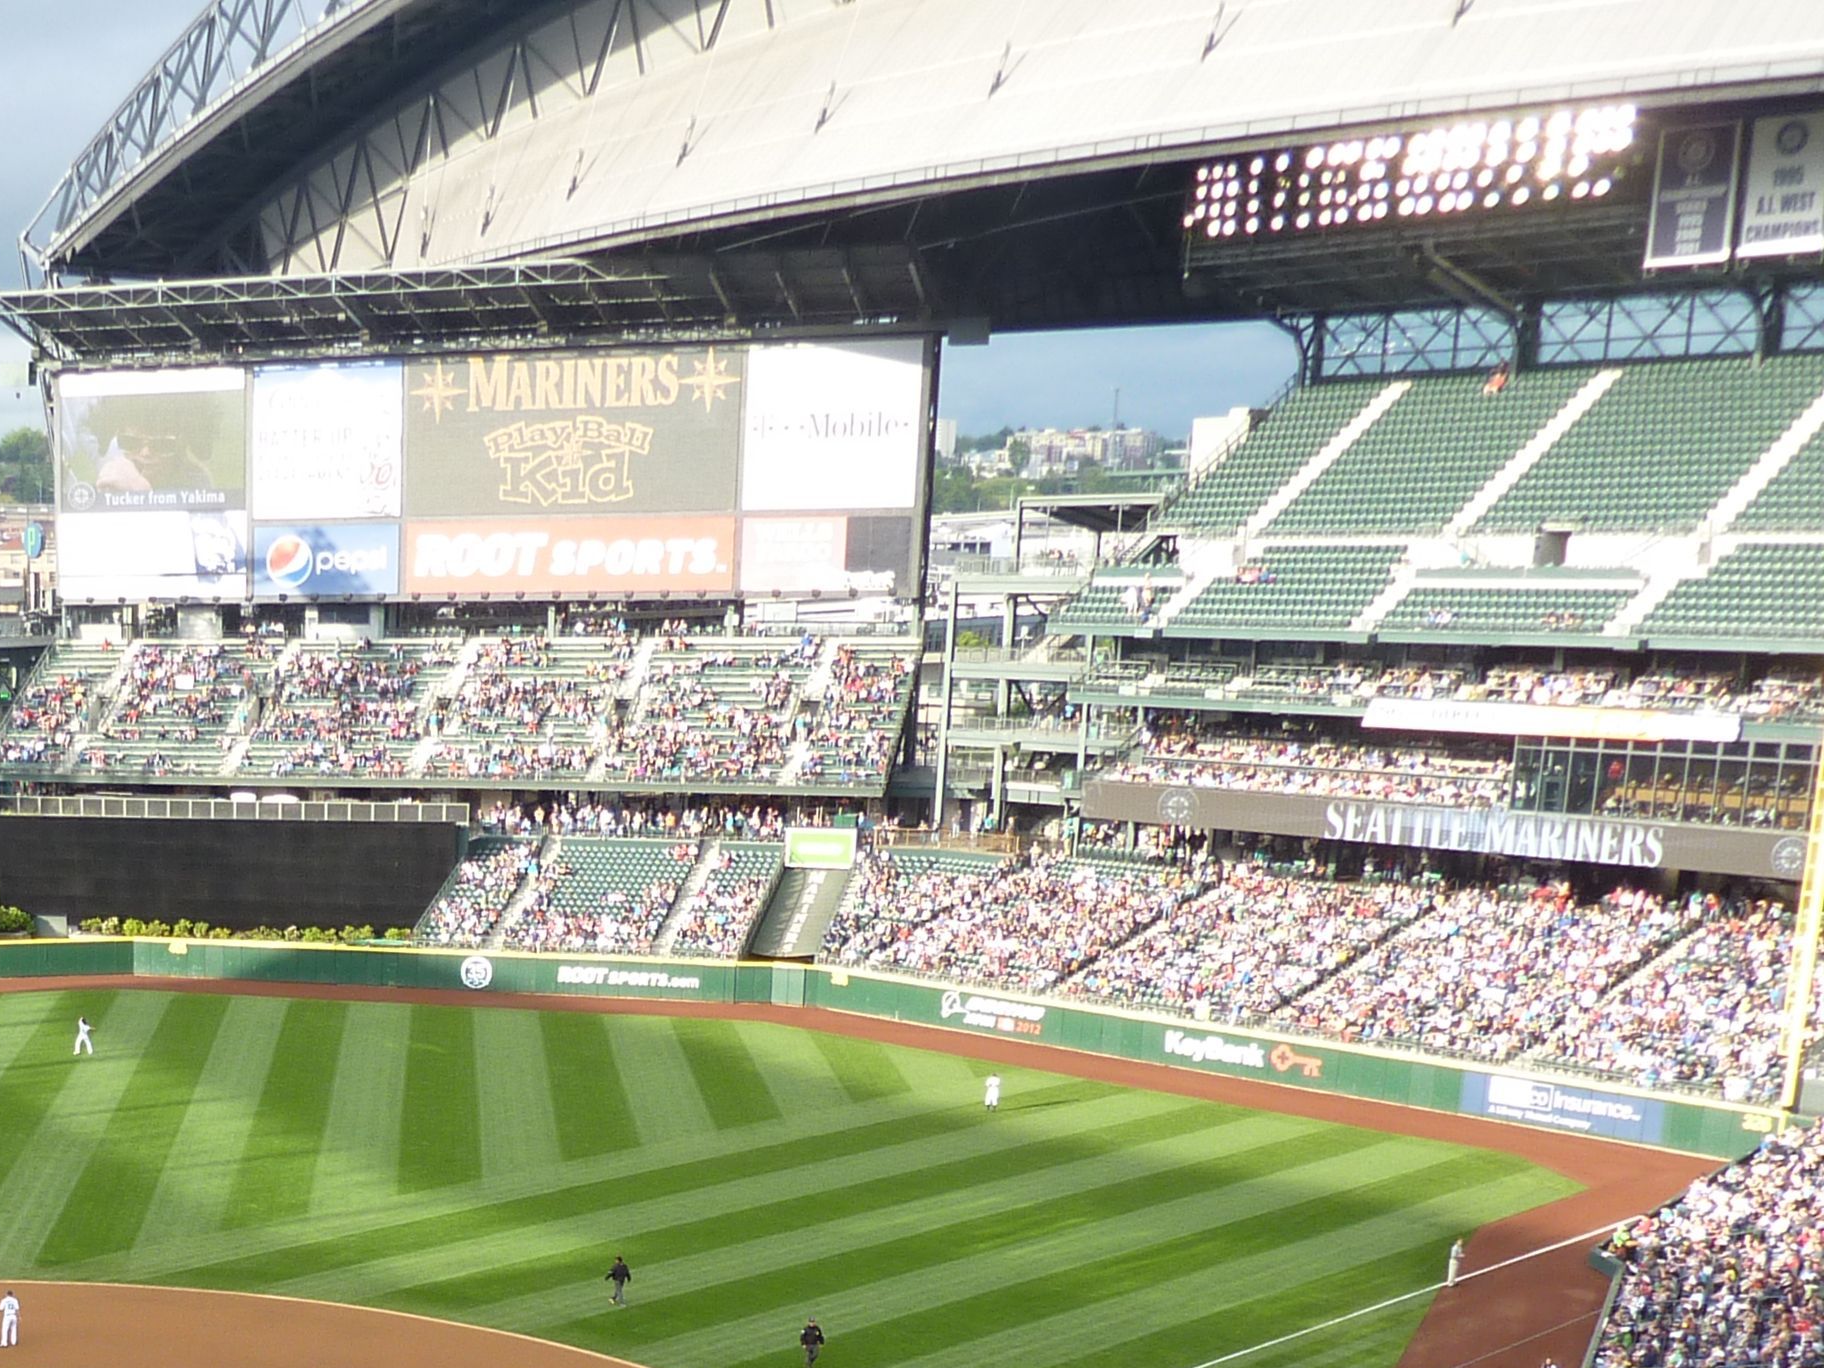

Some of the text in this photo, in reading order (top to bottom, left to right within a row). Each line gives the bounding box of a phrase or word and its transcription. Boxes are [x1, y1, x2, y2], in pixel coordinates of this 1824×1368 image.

[466, 354, 679, 412] MARINERS
[484, 416, 653, 468] Play Ball
[104, 489, 226, 506] Tucker from Yakima
[499, 450, 633, 506] Kid
[414, 531, 550, 578] ROOT
[1325, 801, 1664, 868] SEATTLE MARINERS
[1015, 1020, 1042, 1035] 2012
[1164, 1030, 1265, 1068] KeyBank
